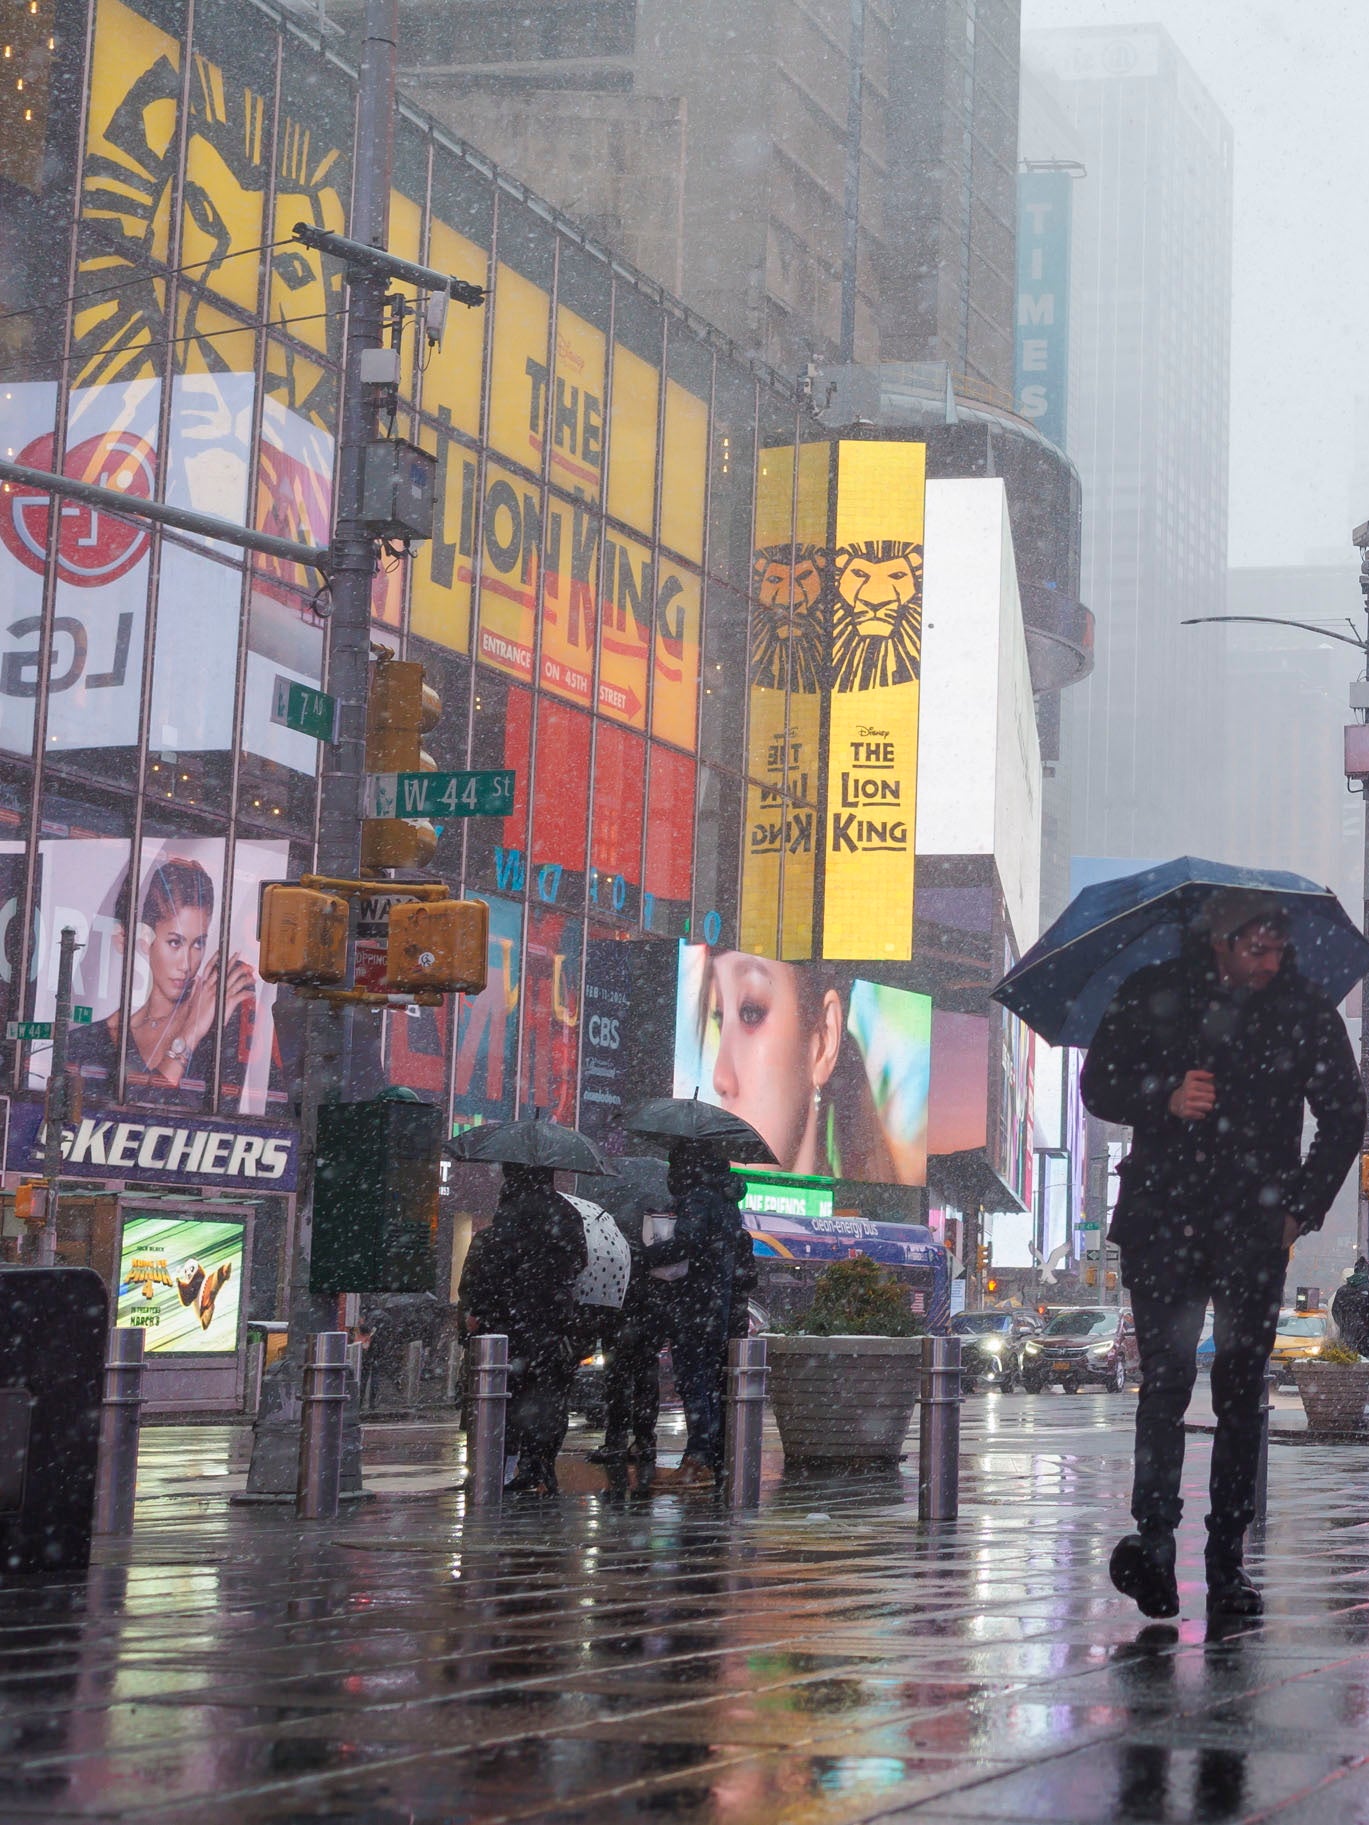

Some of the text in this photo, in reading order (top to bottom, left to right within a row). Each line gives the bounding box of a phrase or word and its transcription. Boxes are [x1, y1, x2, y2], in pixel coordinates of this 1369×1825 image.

[1017, 203, 1054, 417] TIMES
[526, 356, 600, 468] THE
[431, 404, 562, 600] LION
[566, 486, 685, 661] KING
[483, 633, 626, 709] ENTRANCE ON 45TH STREET
[301, 691, 309, 725] 7
[856, 725, 890, 739] Disney
[850, 742, 895, 762] THE
[403, 776, 511, 812] W 44 St
[841, 771, 900, 808] LION
[832, 812, 908, 853] KING
[588, 1014, 621, 1049] CBS
[34, 1118, 292, 1179] SKECHERS
[811, 1219, 879, 1238] clean-energy bus
